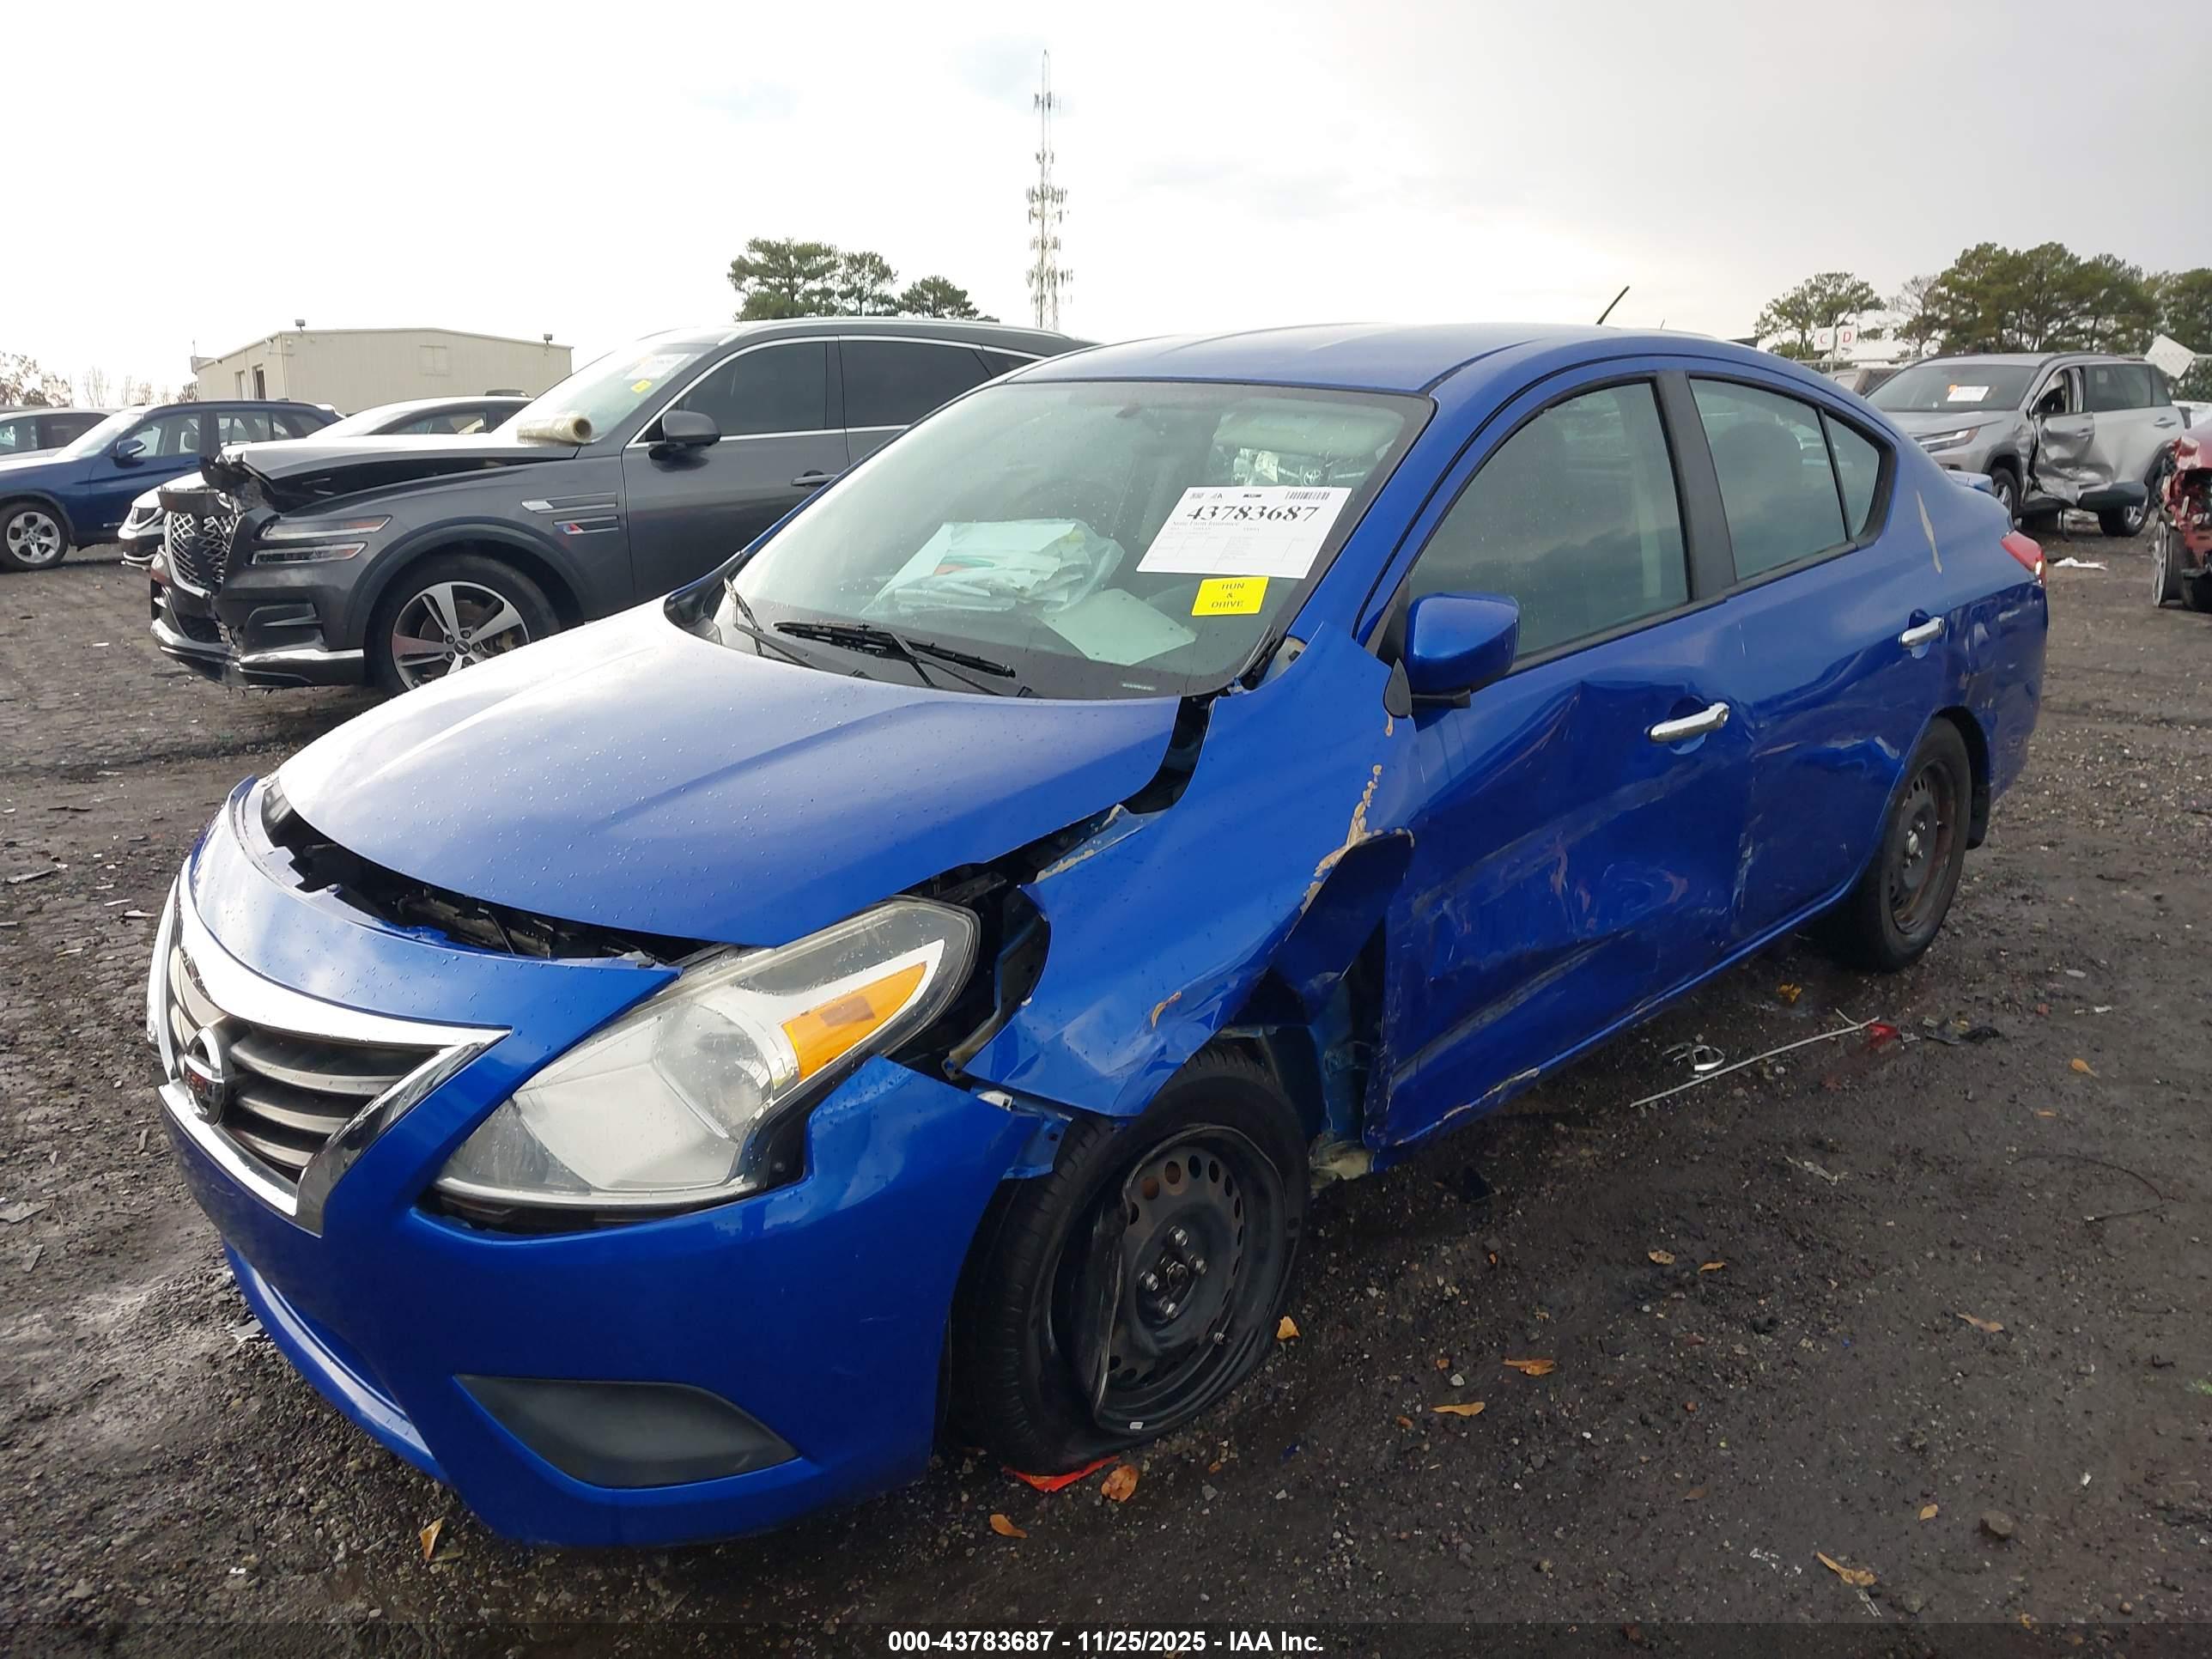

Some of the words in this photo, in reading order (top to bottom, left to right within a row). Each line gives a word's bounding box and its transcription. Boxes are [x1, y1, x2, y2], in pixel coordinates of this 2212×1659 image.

[1820, 332, 1828, 344] C
[1843, 331, 1852, 343] D
[1187, 505, 1321, 522] 43783687
